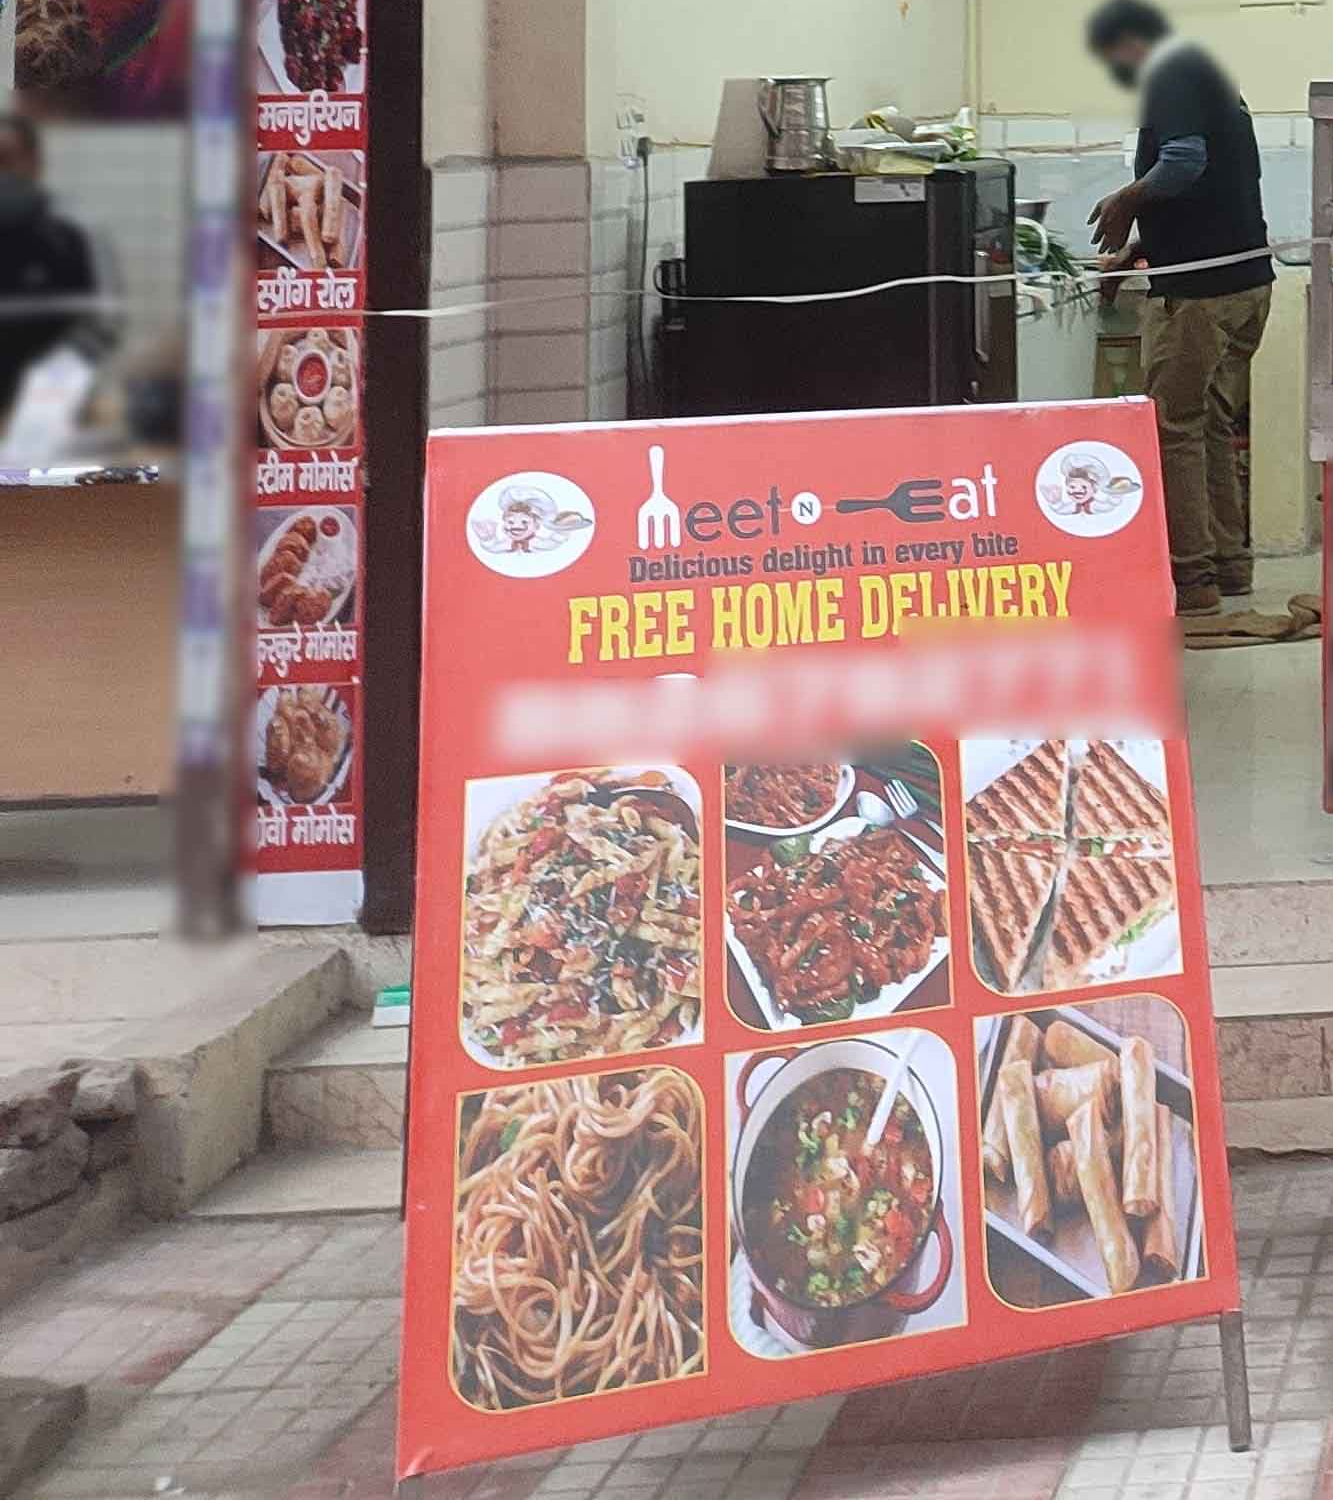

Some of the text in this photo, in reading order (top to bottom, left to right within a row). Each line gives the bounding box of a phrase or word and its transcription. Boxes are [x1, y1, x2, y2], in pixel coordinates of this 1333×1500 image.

[316, 266, 358, 309] रोल
[630, 532, 1018, 583] Delicious delight in every bite
[568, 561, 1073, 664] FREE HOME DELIVERY
